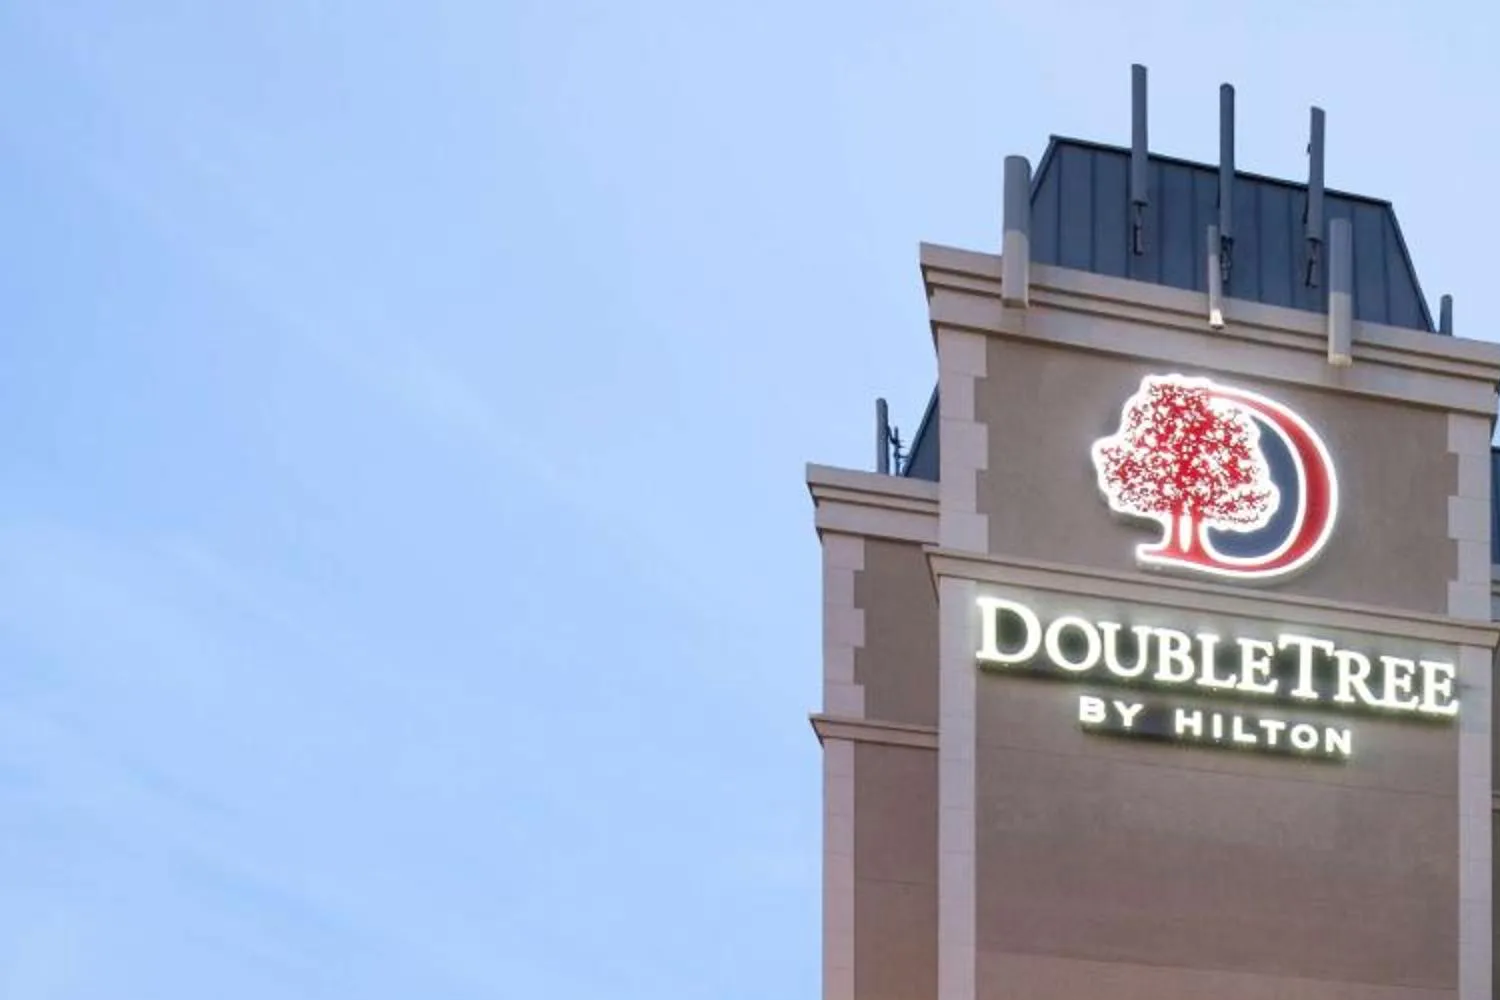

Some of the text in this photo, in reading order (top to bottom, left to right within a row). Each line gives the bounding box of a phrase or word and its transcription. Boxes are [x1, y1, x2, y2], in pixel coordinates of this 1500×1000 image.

[975, 597, 1459, 716] DOUBLETREE
[1079, 695, 1352, 756] BY HILTON
